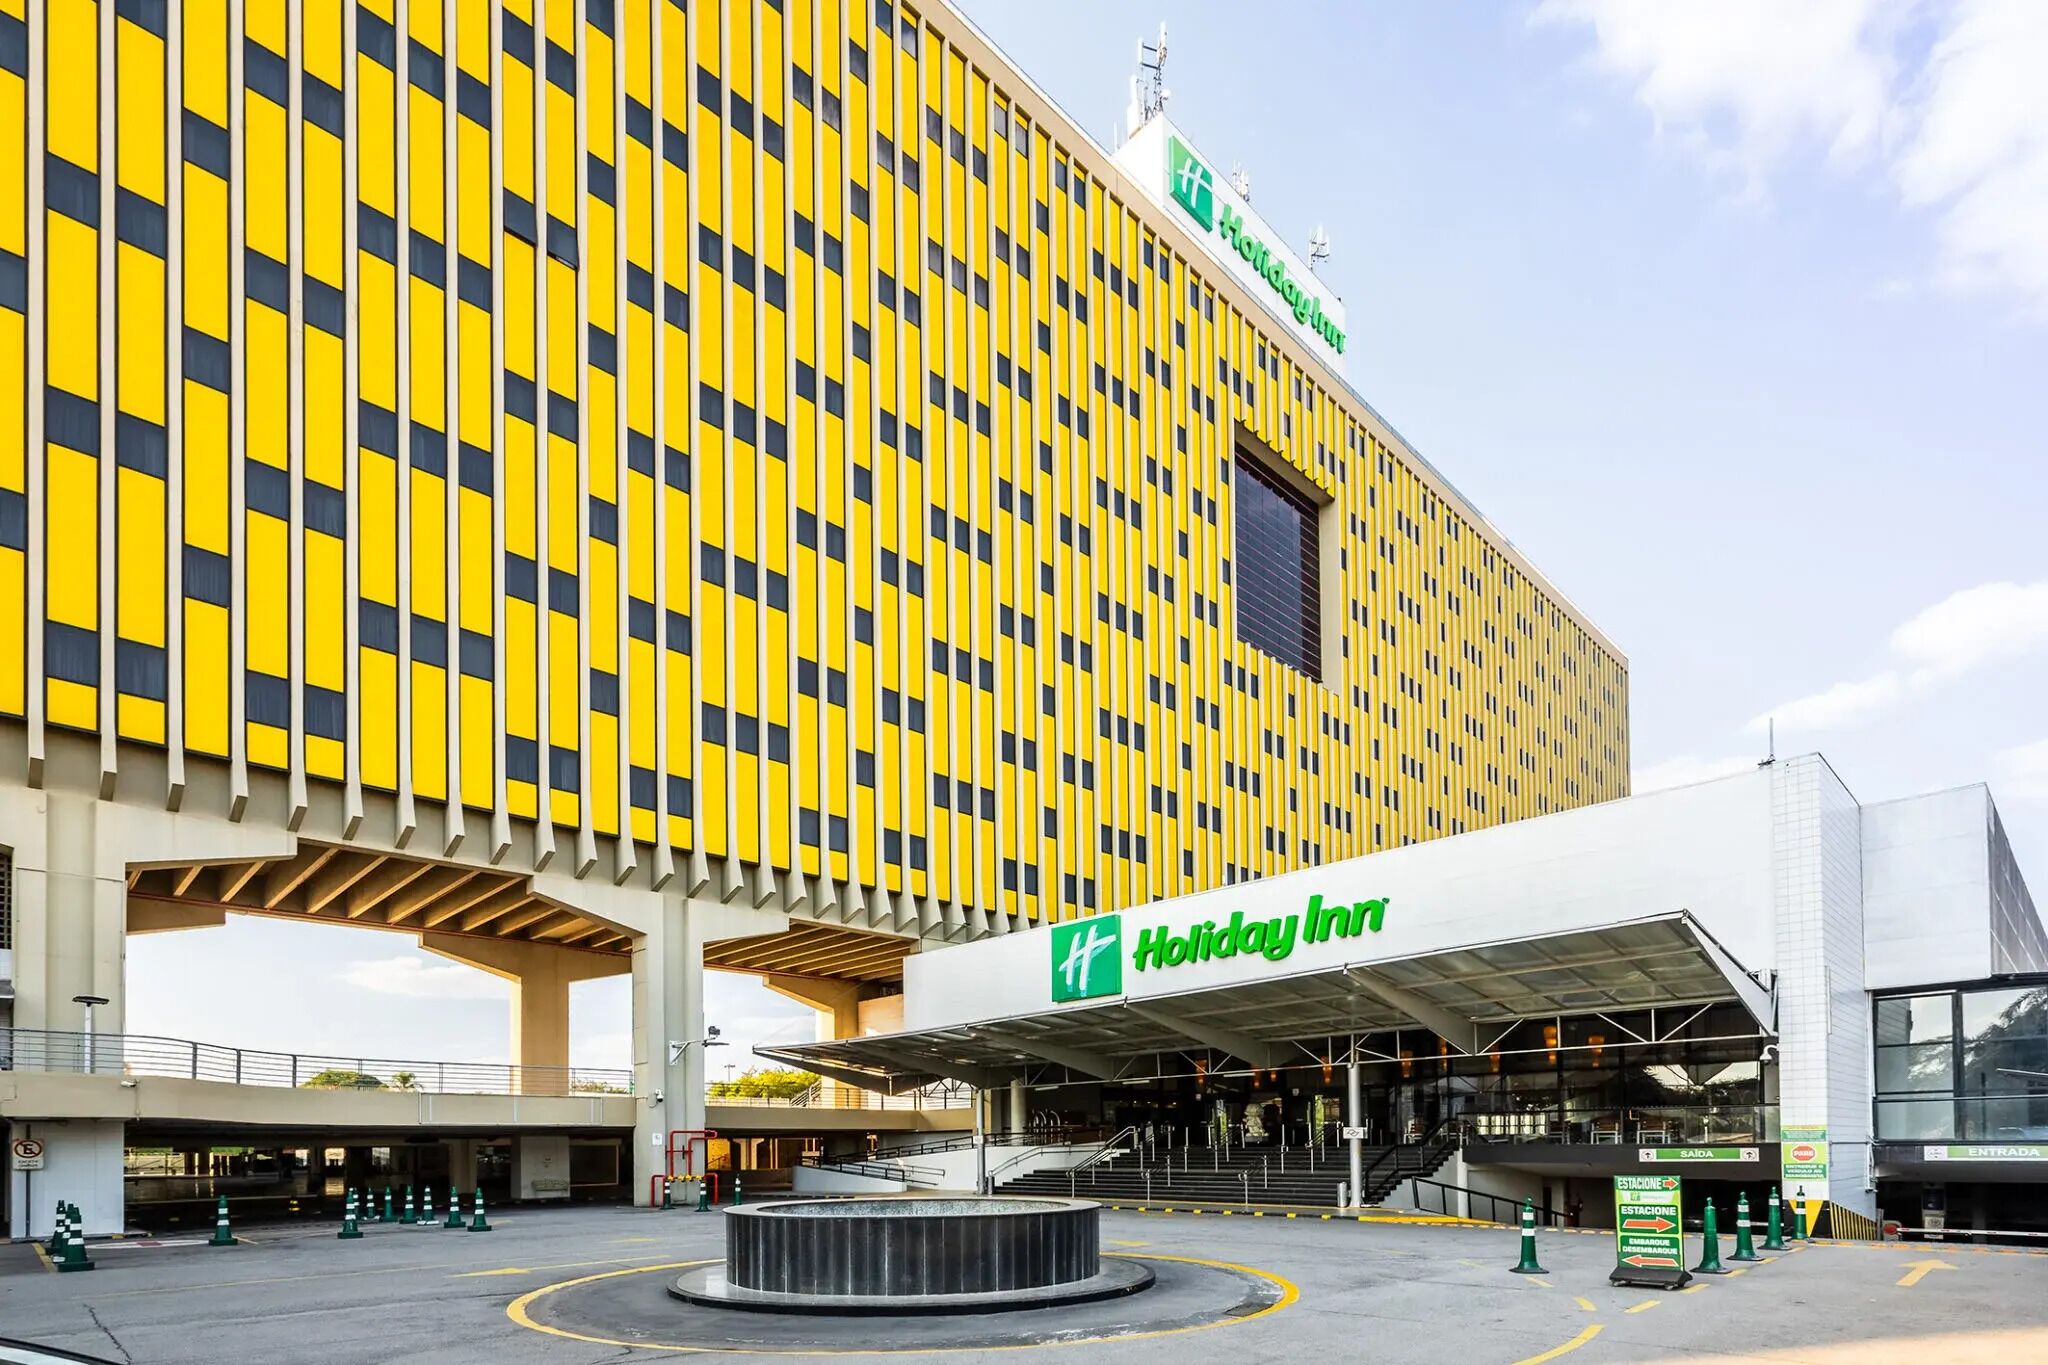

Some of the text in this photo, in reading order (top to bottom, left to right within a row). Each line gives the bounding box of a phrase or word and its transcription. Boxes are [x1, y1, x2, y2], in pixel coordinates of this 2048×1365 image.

[1219, 204, 1346, 354] Holiday Inn
[1133, 894, 1389, 972] Holiday Inn
[23, 1143, 33, 1154] E
[1680, 1149, 1714, 1158] SAÍDA
[1968, 1148, 2040, 1157] ENTRADA
[1617, 1177, 1662, 1190] ESTACIONE
[1621, 1206, 1677, 1216] ESTACIONE
[1629, 1238, 1670, 1246] EMBARQUE
[1622, 1246, 1678, 1255] DESEMBARQUE
